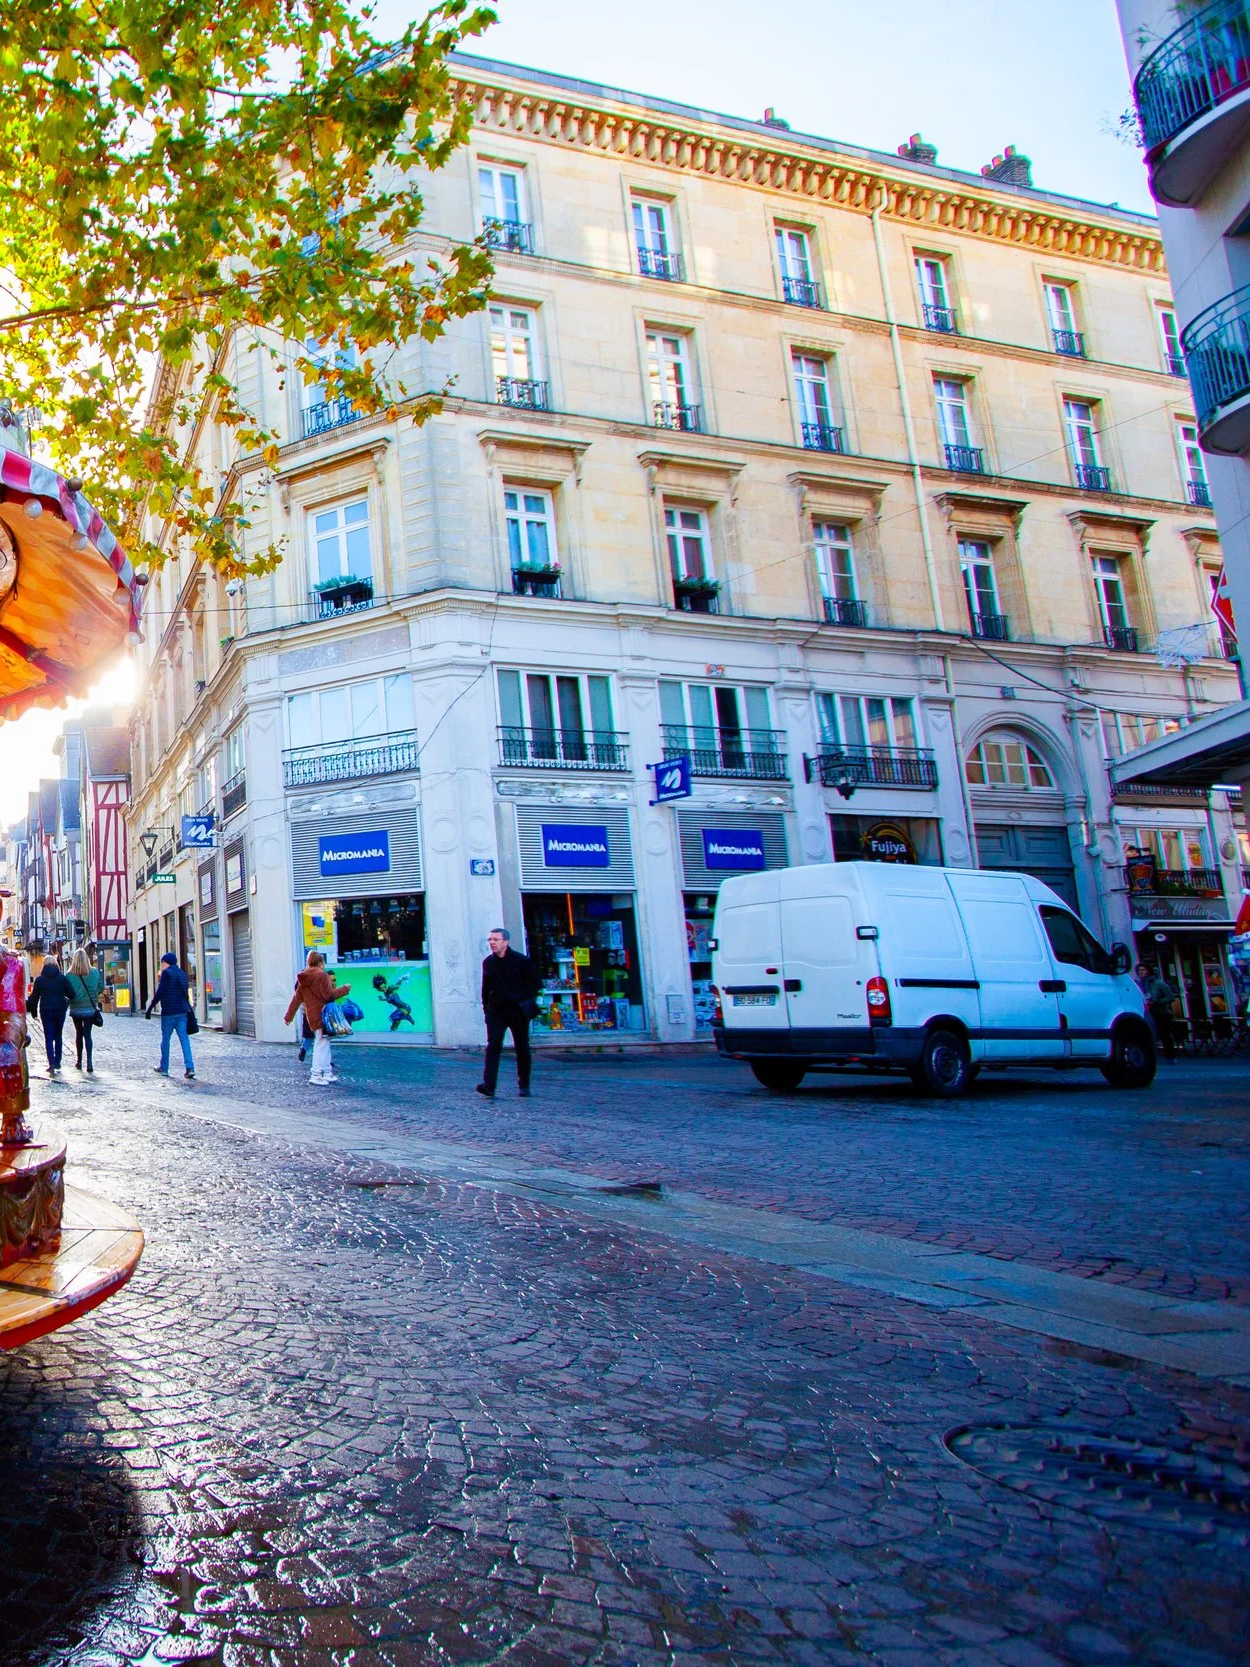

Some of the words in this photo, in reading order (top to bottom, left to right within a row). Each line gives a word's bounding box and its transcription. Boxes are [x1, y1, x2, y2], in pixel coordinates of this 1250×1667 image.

[548, 839, 607, 853] MICROMANIA
[709, 842, 763, 856] MICROMANIA
[871, 840, 907, 855] Fujiya
[322, 848, 385, 862] MICROMANIA
